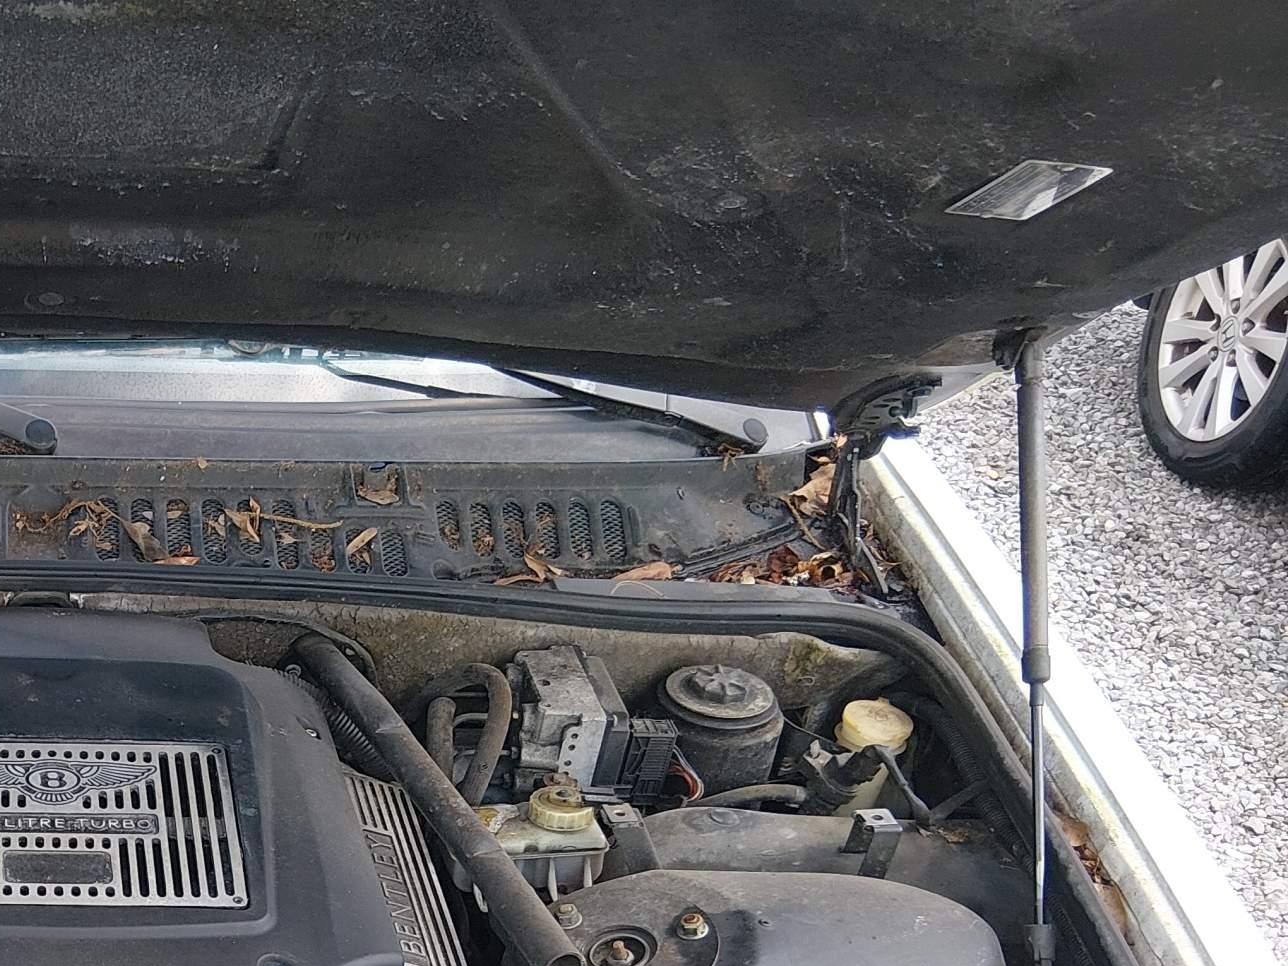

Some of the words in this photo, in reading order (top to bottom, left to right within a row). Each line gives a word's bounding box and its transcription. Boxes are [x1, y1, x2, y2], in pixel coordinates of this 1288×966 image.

[39, 771, 67, 788] B
[4, 817, 65, 828] LITRE
[75, 818, 152, 830] TURBO
[366, 834, 427, 957] BENTLEY
